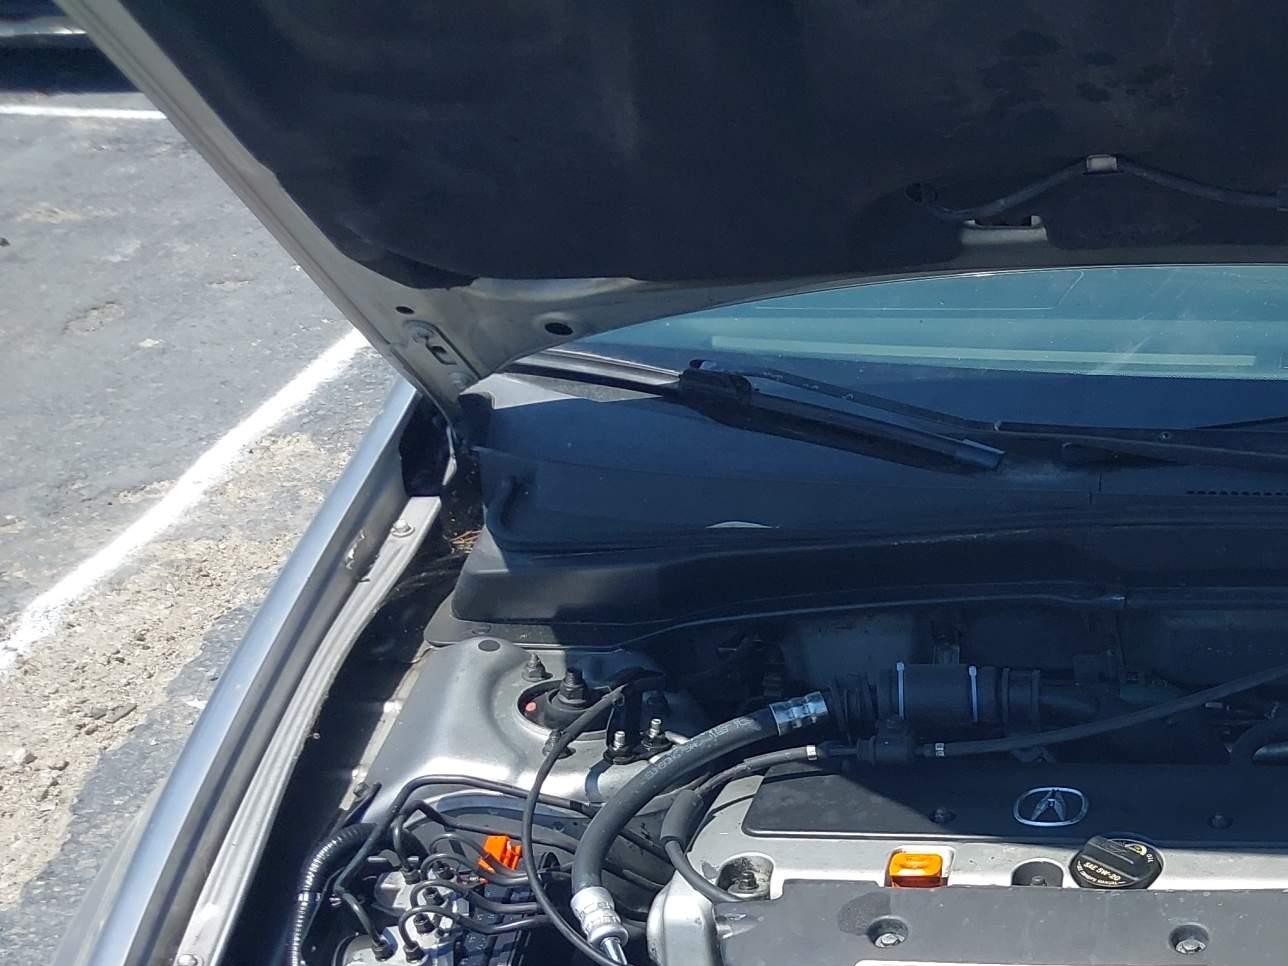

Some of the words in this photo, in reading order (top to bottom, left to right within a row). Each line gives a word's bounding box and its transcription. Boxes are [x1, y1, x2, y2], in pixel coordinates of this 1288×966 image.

[1145, 853, 1154, 863] OIL
[1083, 862, 1097, 871] SAE
[1096, 867, 1121, 881] 5W-20
